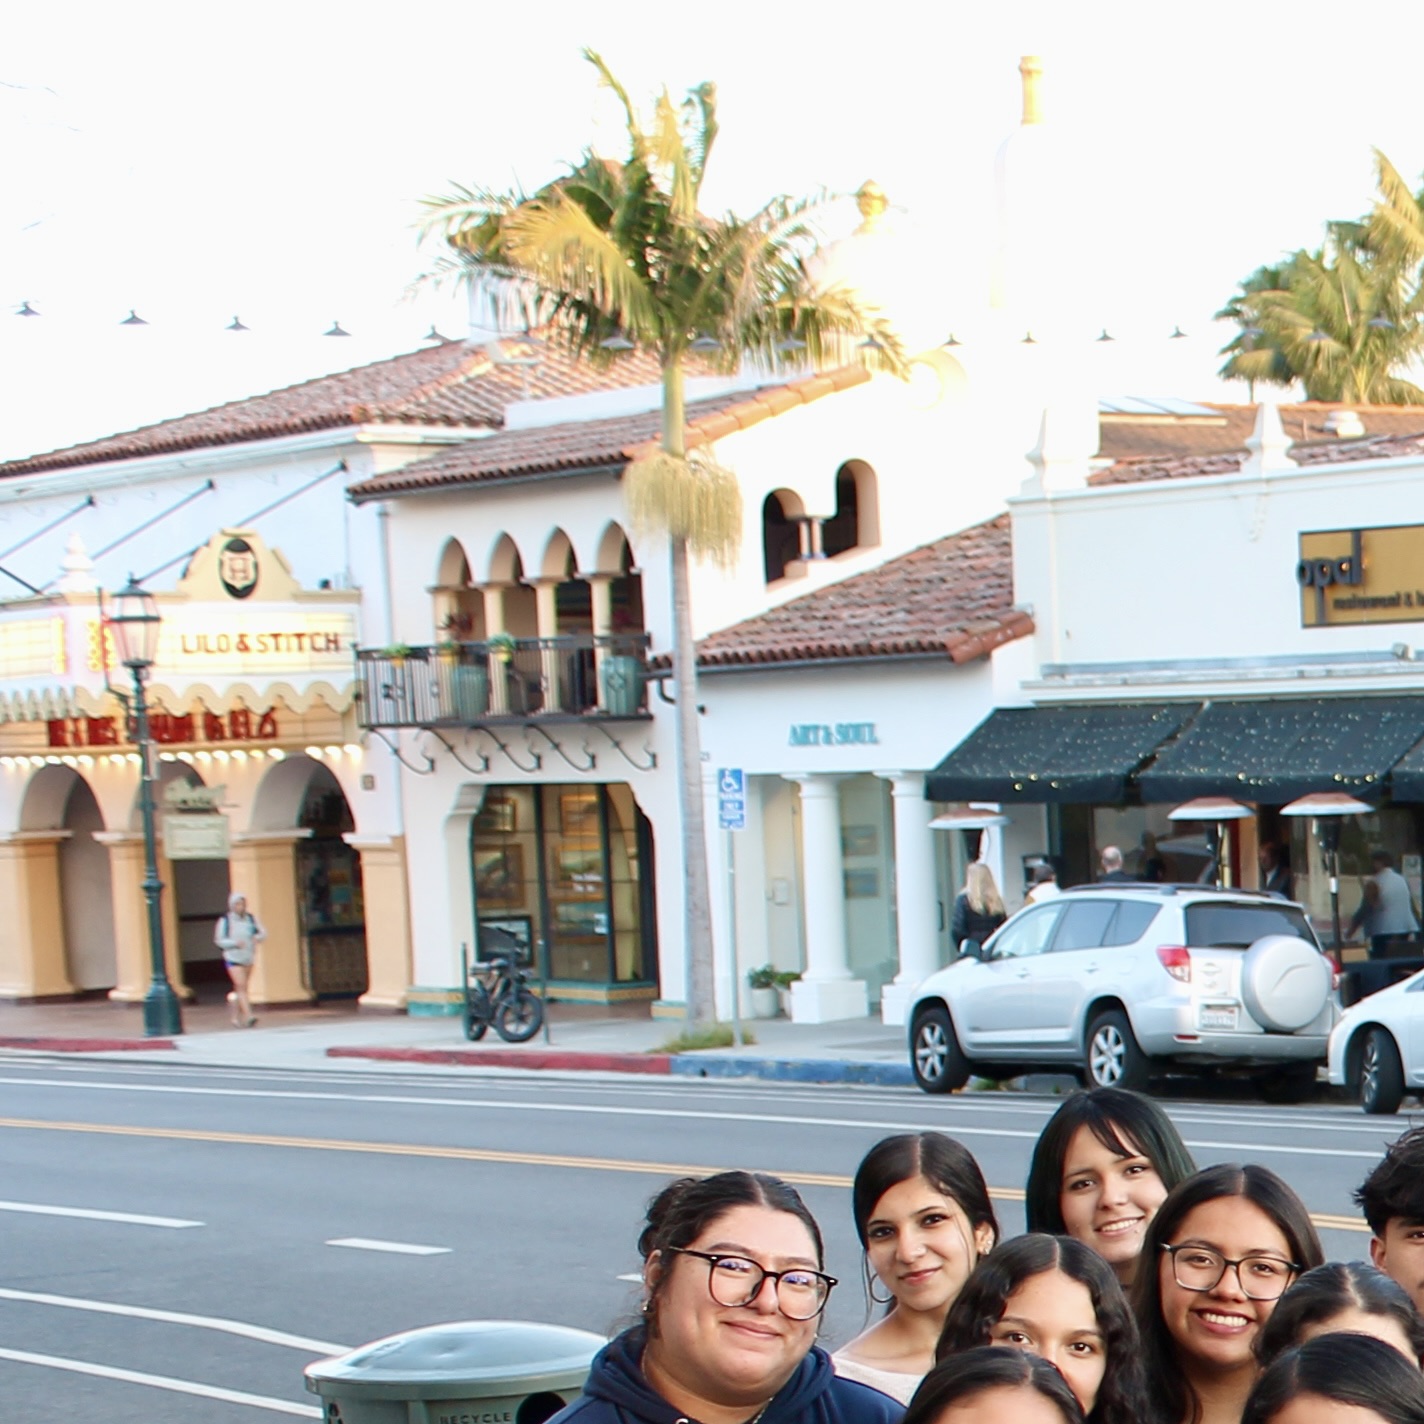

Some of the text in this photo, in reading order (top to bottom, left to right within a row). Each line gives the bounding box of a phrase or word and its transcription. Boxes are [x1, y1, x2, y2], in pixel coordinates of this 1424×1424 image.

[181, 631, 341, 654] LILO & STITCH
[789, 723, 822, 746] ART
[835, 721, 880, 745] SOUL
[440, 1412, 511, 1424] RECYCLE
